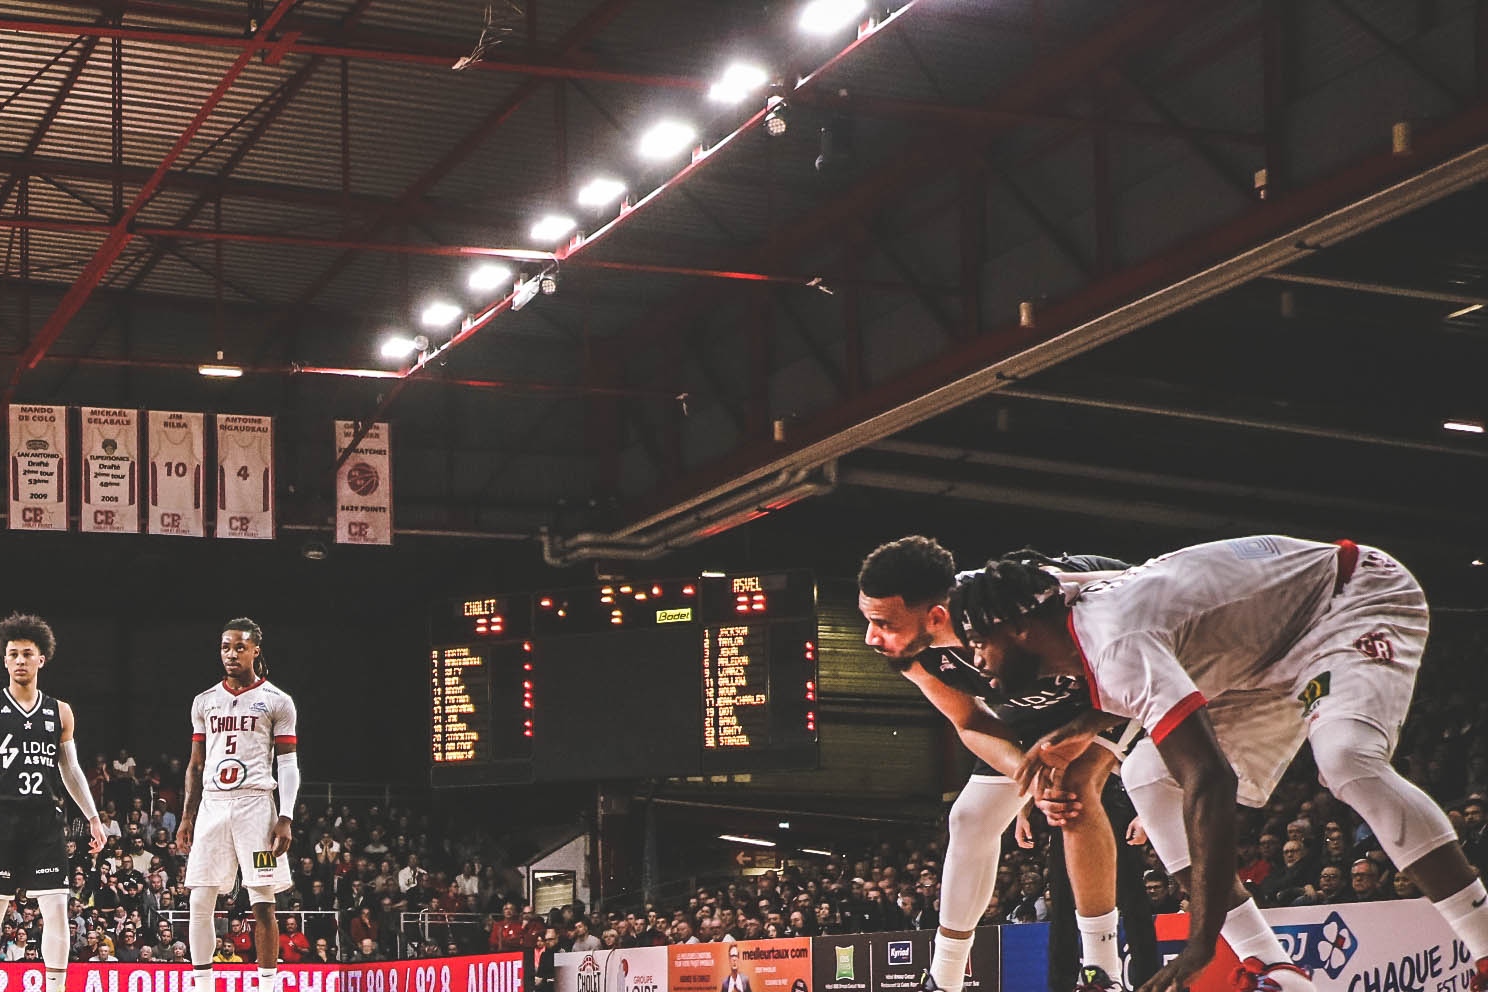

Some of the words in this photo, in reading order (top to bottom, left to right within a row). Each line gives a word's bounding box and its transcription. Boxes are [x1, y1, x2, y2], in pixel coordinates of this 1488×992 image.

[164, 461, 187, 477] 10
[237, 465, 249, 480] 4
[733, 577, 762, 592] ASVEL
[464, 599, 496, 616] CHOLET
[658, 611, 691, 622] Bodet
[718, 637, 744, 647] TAYLOR
[210, 715, 259, 733] CHOLET
[23, 741, 57, 756] LDLC
[226, 735, 237, 754] 5
[220, 767, 238, 784] U
[18, 772, 43, 795] 32
[890, 947, 910, 958] Kyriad
[1277, 932, 1308, 961] DJ
[634, 975, 653, 984] GROUPE
